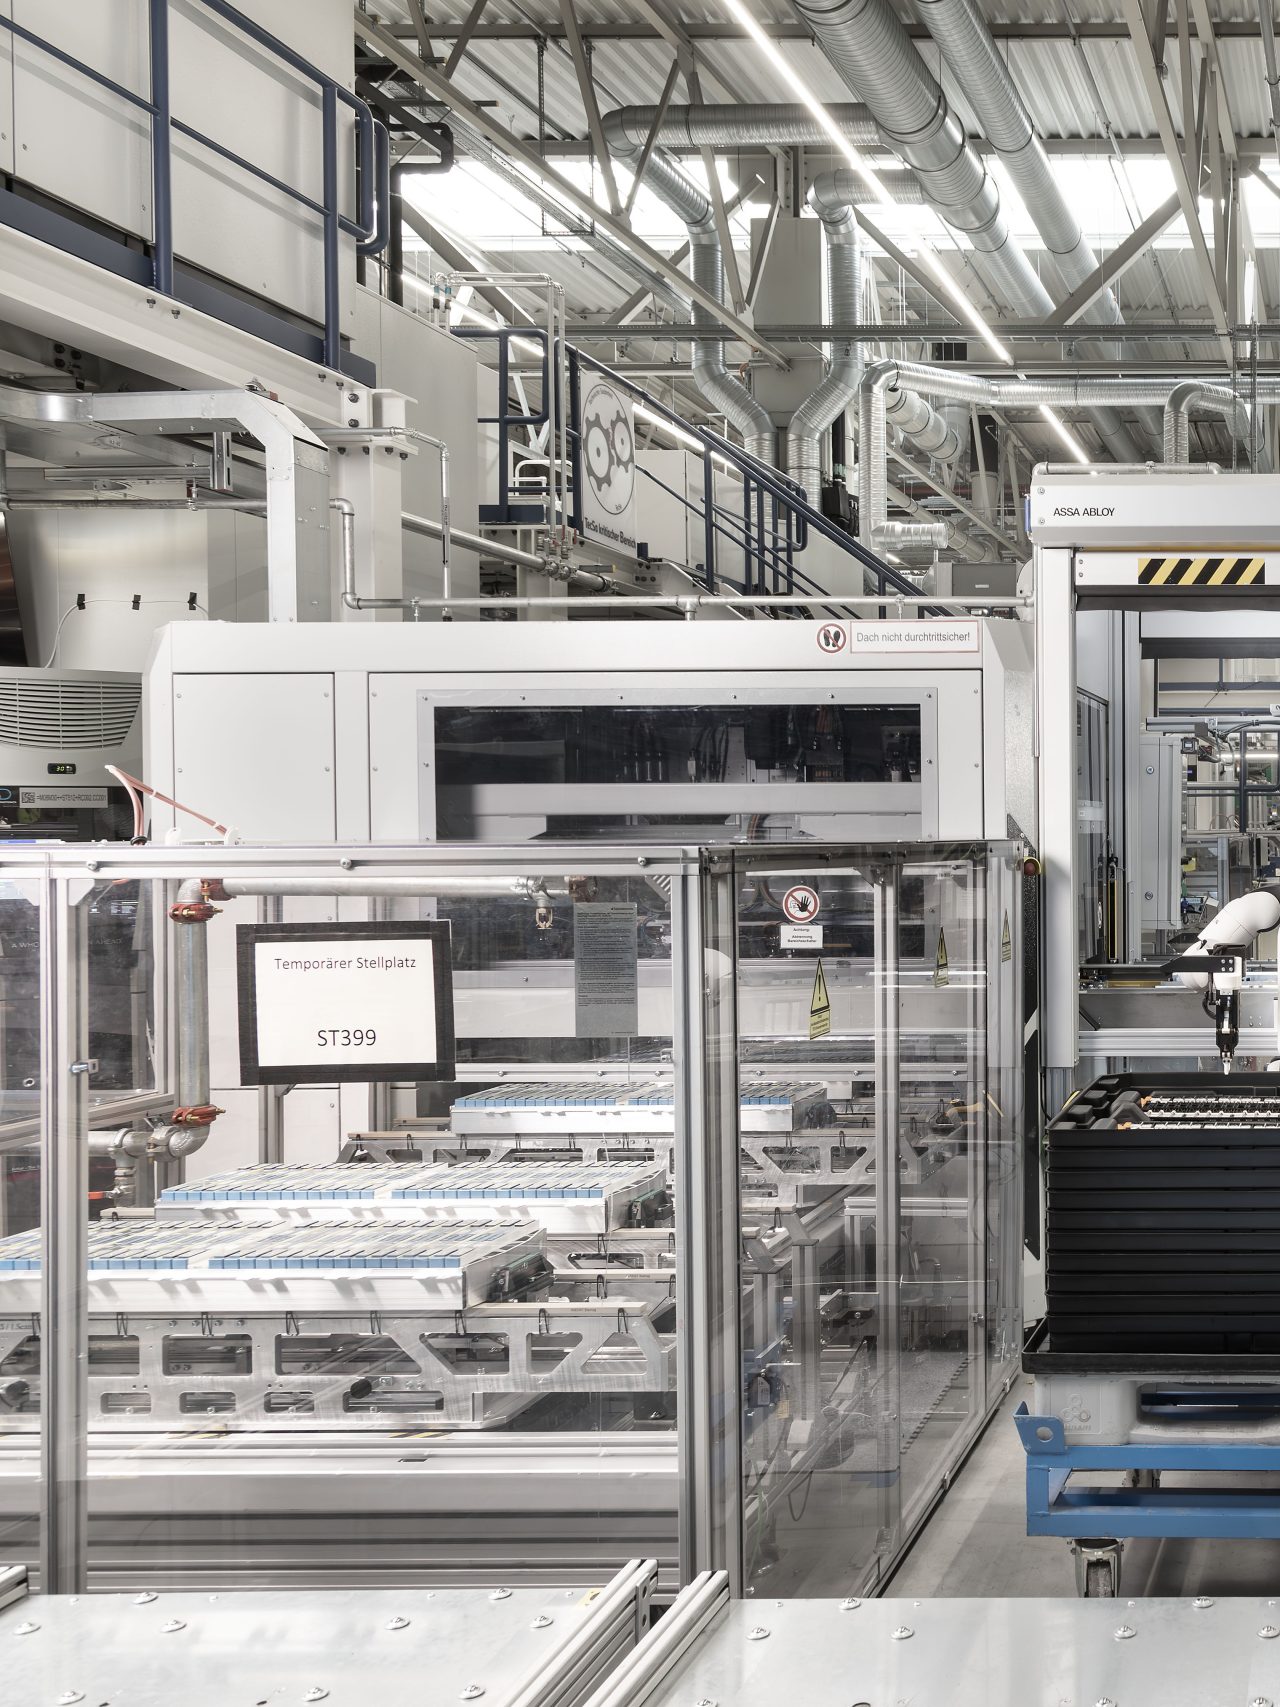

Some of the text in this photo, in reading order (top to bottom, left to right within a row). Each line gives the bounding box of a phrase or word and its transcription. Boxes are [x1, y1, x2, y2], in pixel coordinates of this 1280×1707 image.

[1053, 507, 1115, 517] ASSA ABLOY
[584, 517, 637, 549] TecSo kritischer Bereich
[856, 632, 970, 642] Dach nicht durchtrittsicher!
[274, 956, 417, 972] Temporärer Stellplatz
[317, 1029, 377, 1047] ST399
